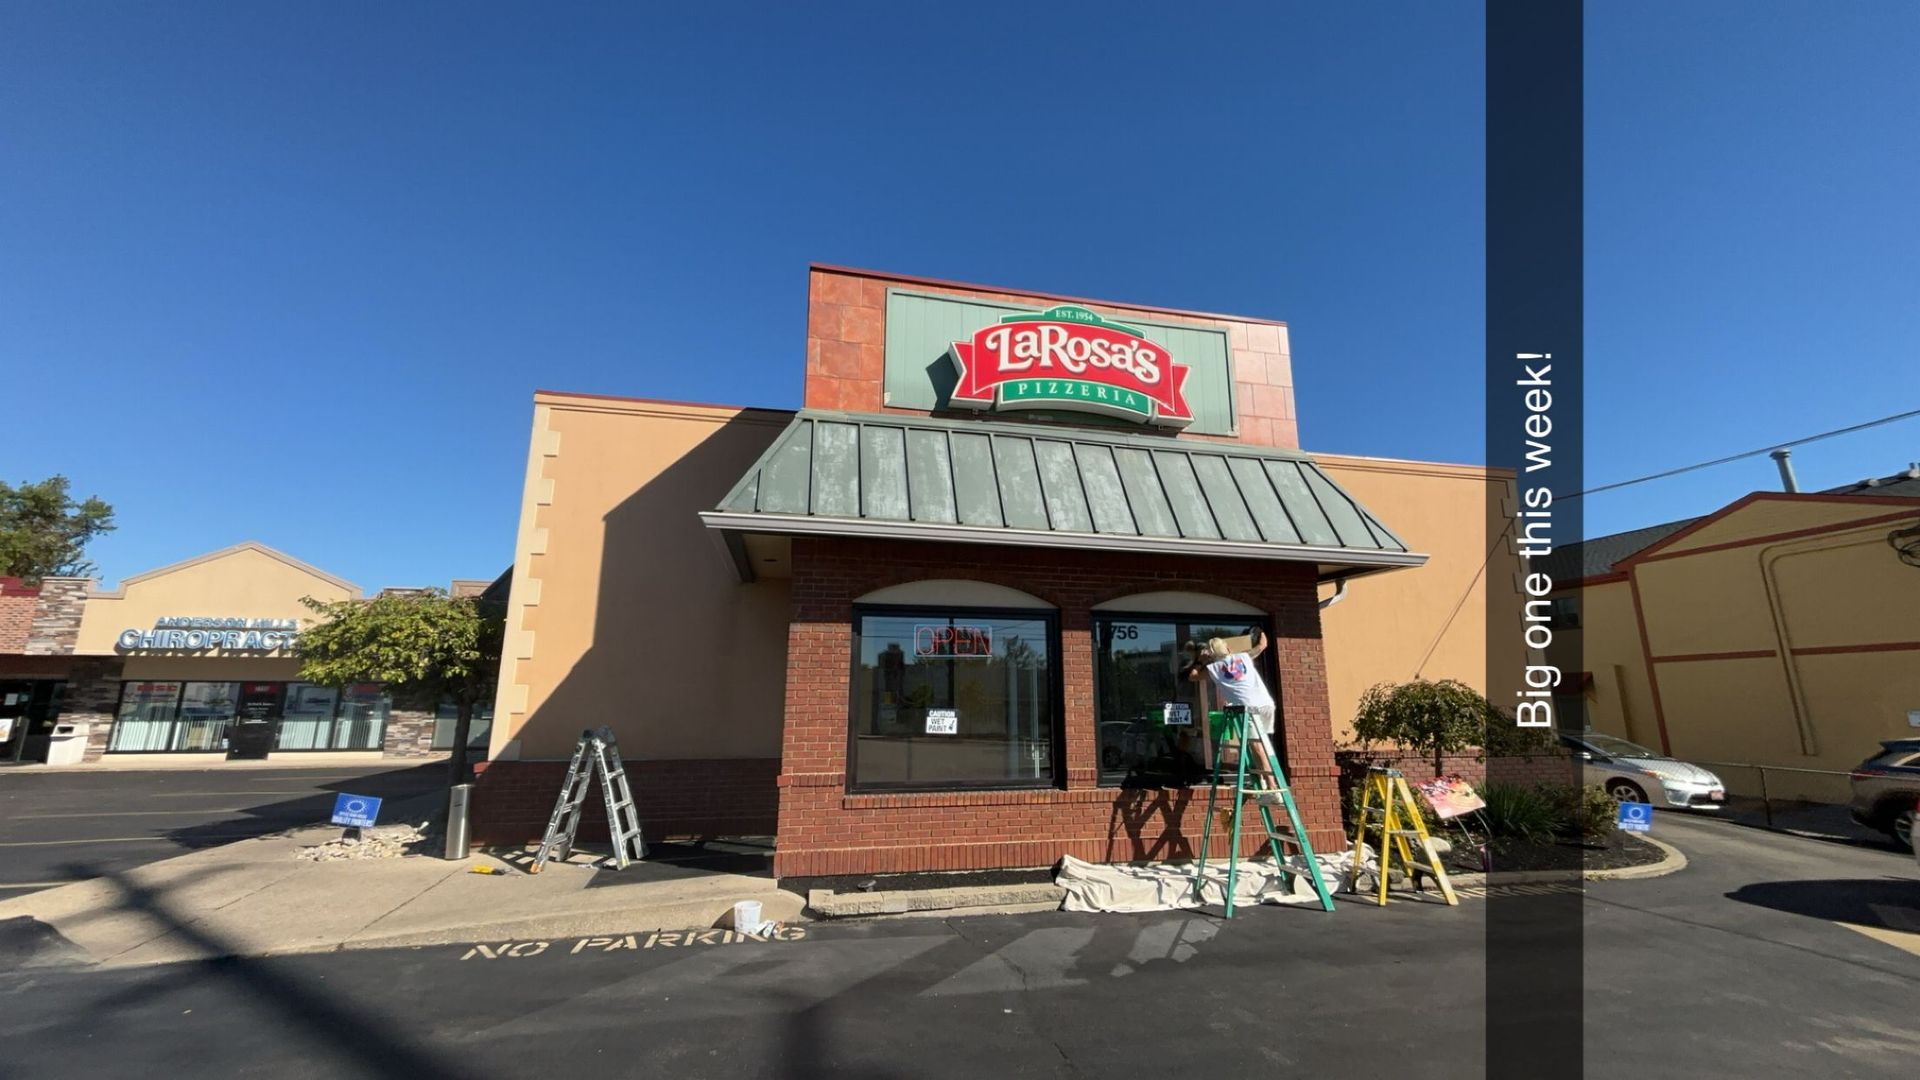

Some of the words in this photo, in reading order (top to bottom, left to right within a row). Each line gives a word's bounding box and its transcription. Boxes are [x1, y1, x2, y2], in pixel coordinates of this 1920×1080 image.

[1056, 309, 1074, 320] EST.
[1075, 311, 1093, 321] 1954
[985, 325, 1160, 383] LaRosa's
[1018, 382, 1136, 406] PIZZERIA
[156, 617, 246, 629] ANDERSON
[917, 626, 992, 656] OPEN
[459, 942, 549, 961] NO
[570, 926, 806, 955] PARKING
